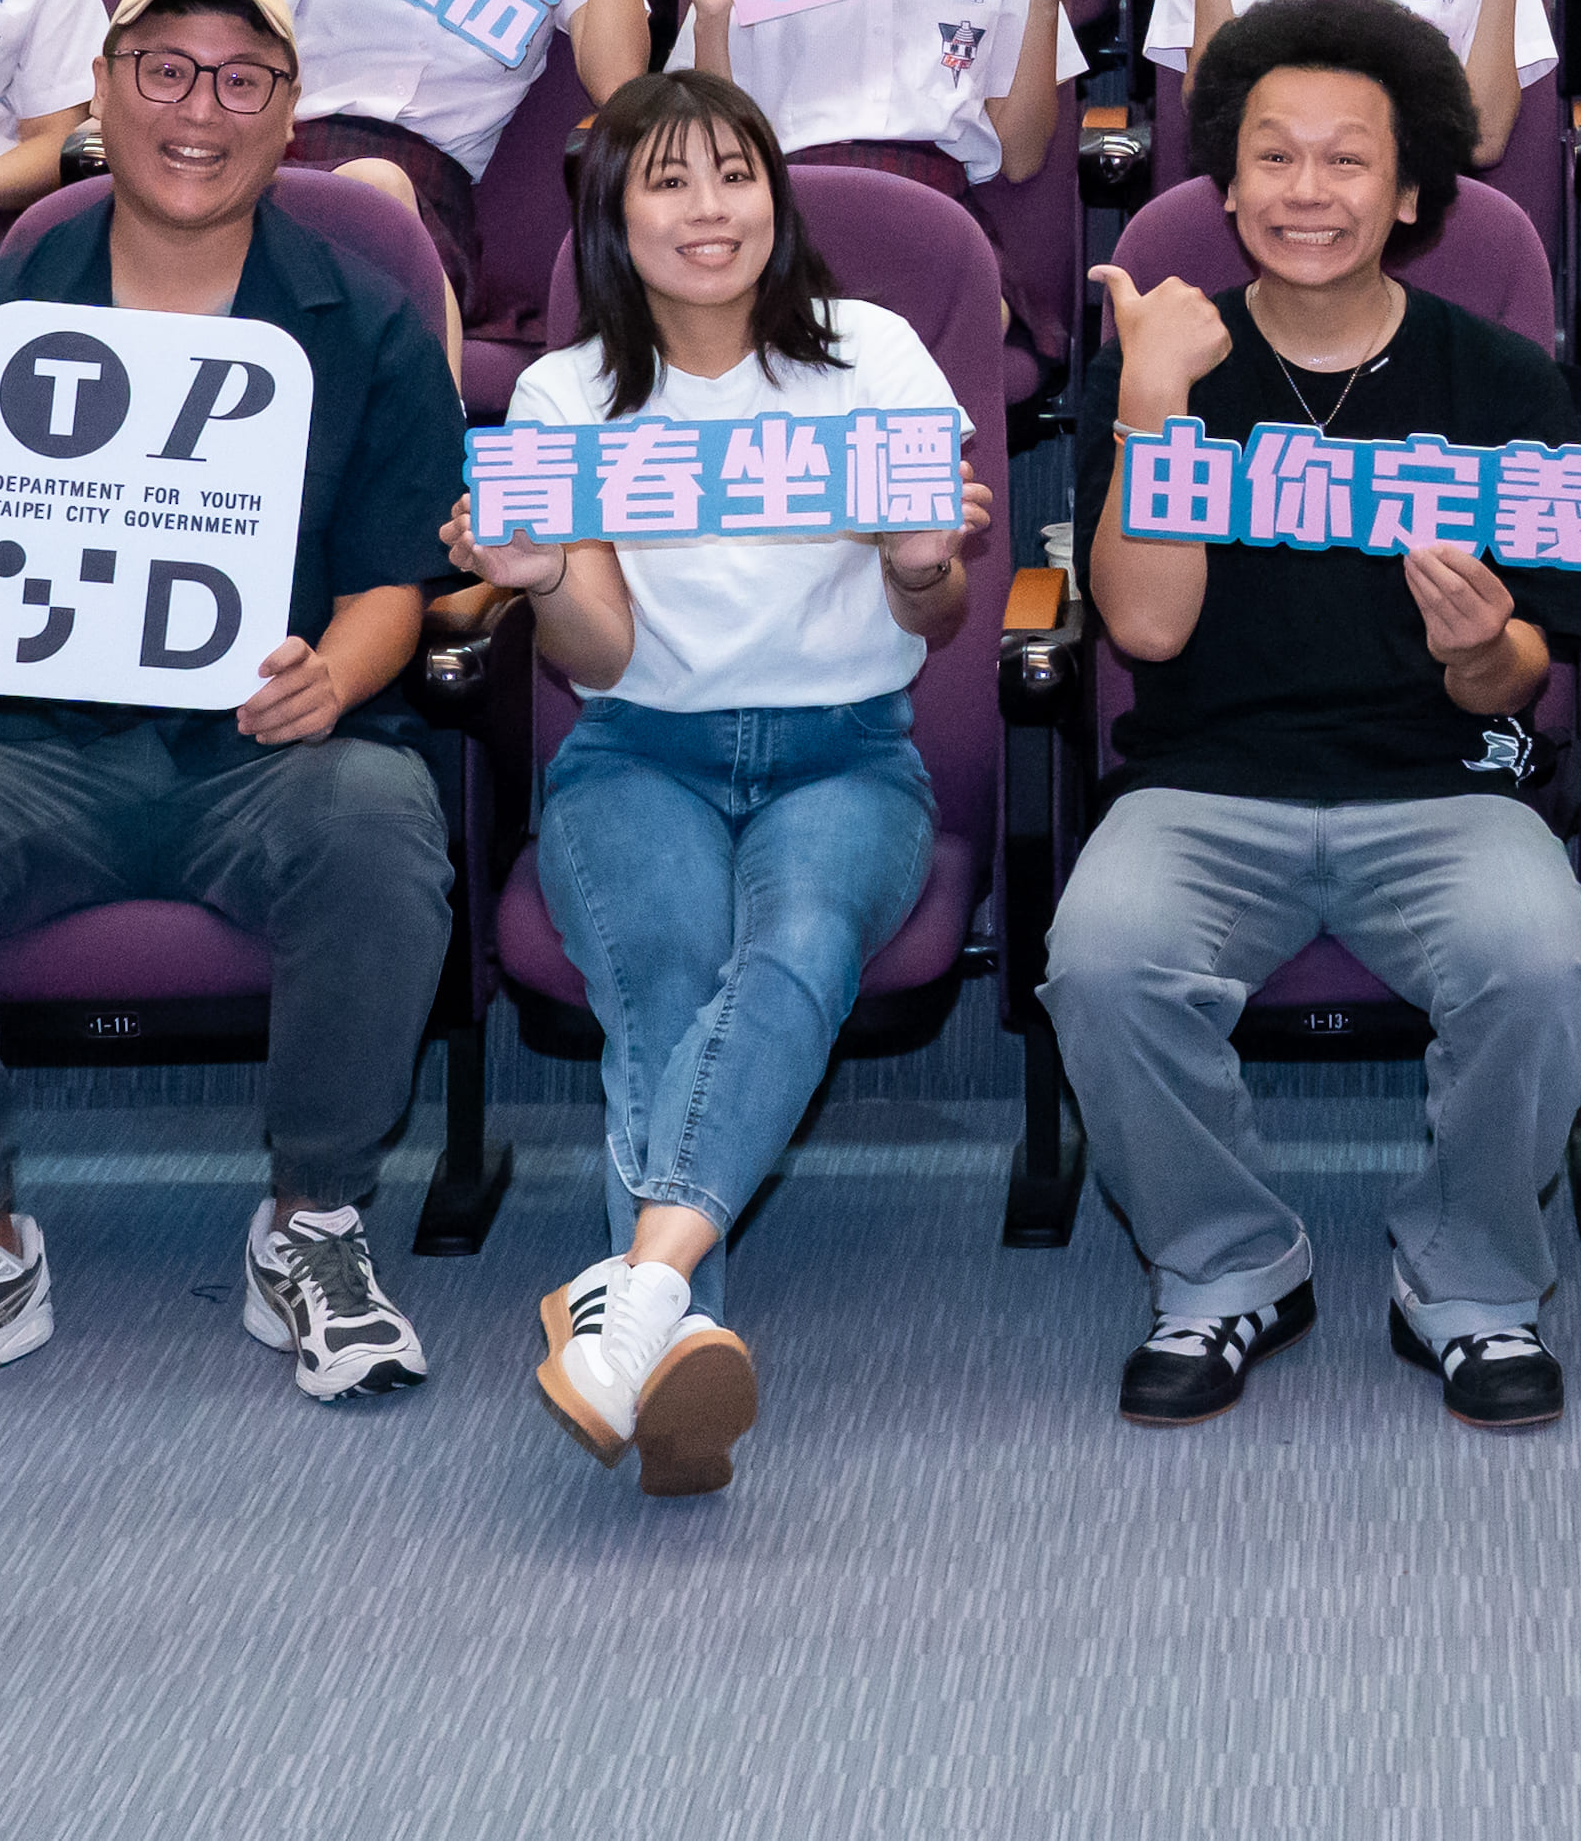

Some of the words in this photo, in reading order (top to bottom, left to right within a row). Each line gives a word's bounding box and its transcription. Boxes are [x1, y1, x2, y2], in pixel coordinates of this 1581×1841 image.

[470, 416, 955, 536] 青春坐標
[143, 485, 180, 505] FOR
[200, 490, 261, 512] YOUTH
[65, 505, 109, 525] CITY
[124, 510, 260, 536] GOVERNMENT
[139, 558, 242, 669] D
[96, 1017, 129, 1033] 1-11
[1310, 1013, 1343, 1029] 1-13
